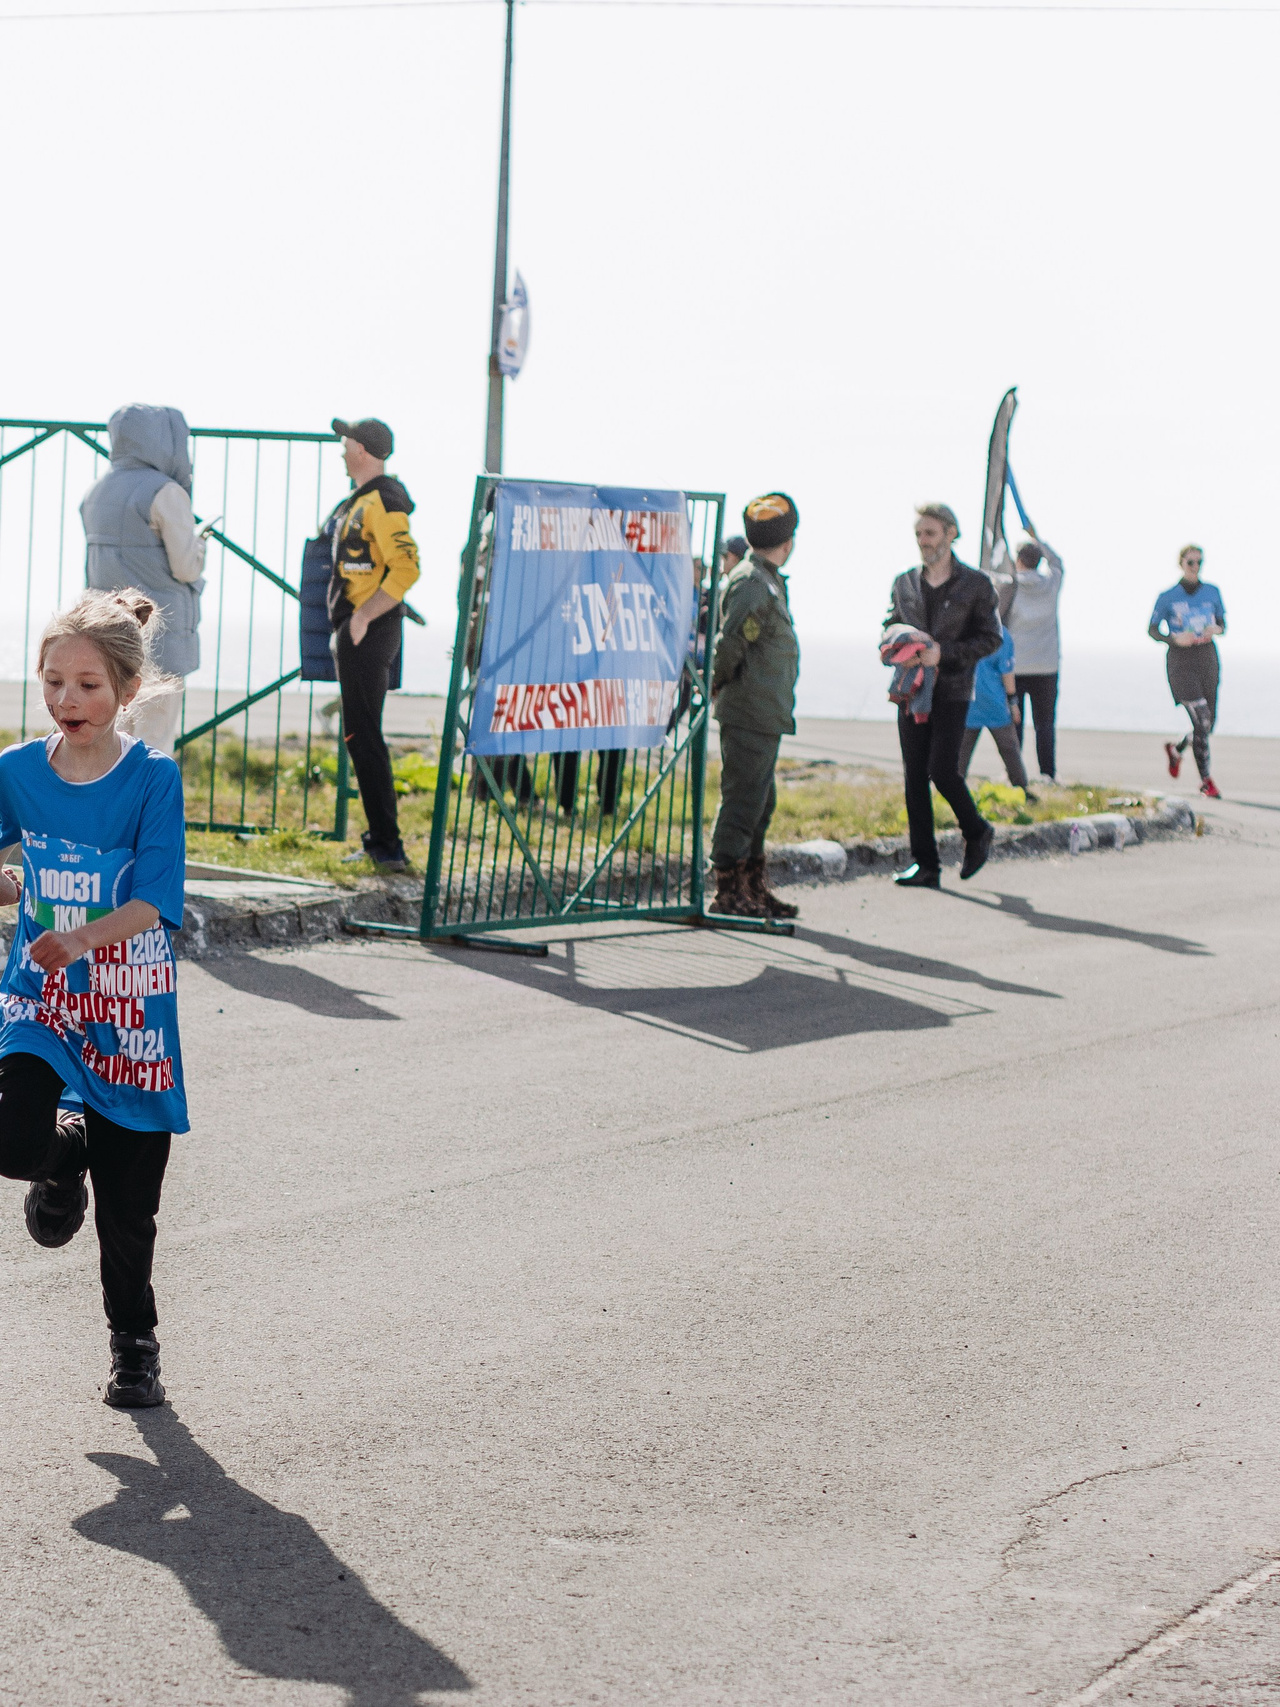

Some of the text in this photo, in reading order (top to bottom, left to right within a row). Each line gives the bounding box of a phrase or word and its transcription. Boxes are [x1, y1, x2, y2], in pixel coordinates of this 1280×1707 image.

[490, 679, 627, 733] #АДРЕНАЛИН
[38, 867, 101, 903] 10031
[116, 1027, 165, 1061] 2024
